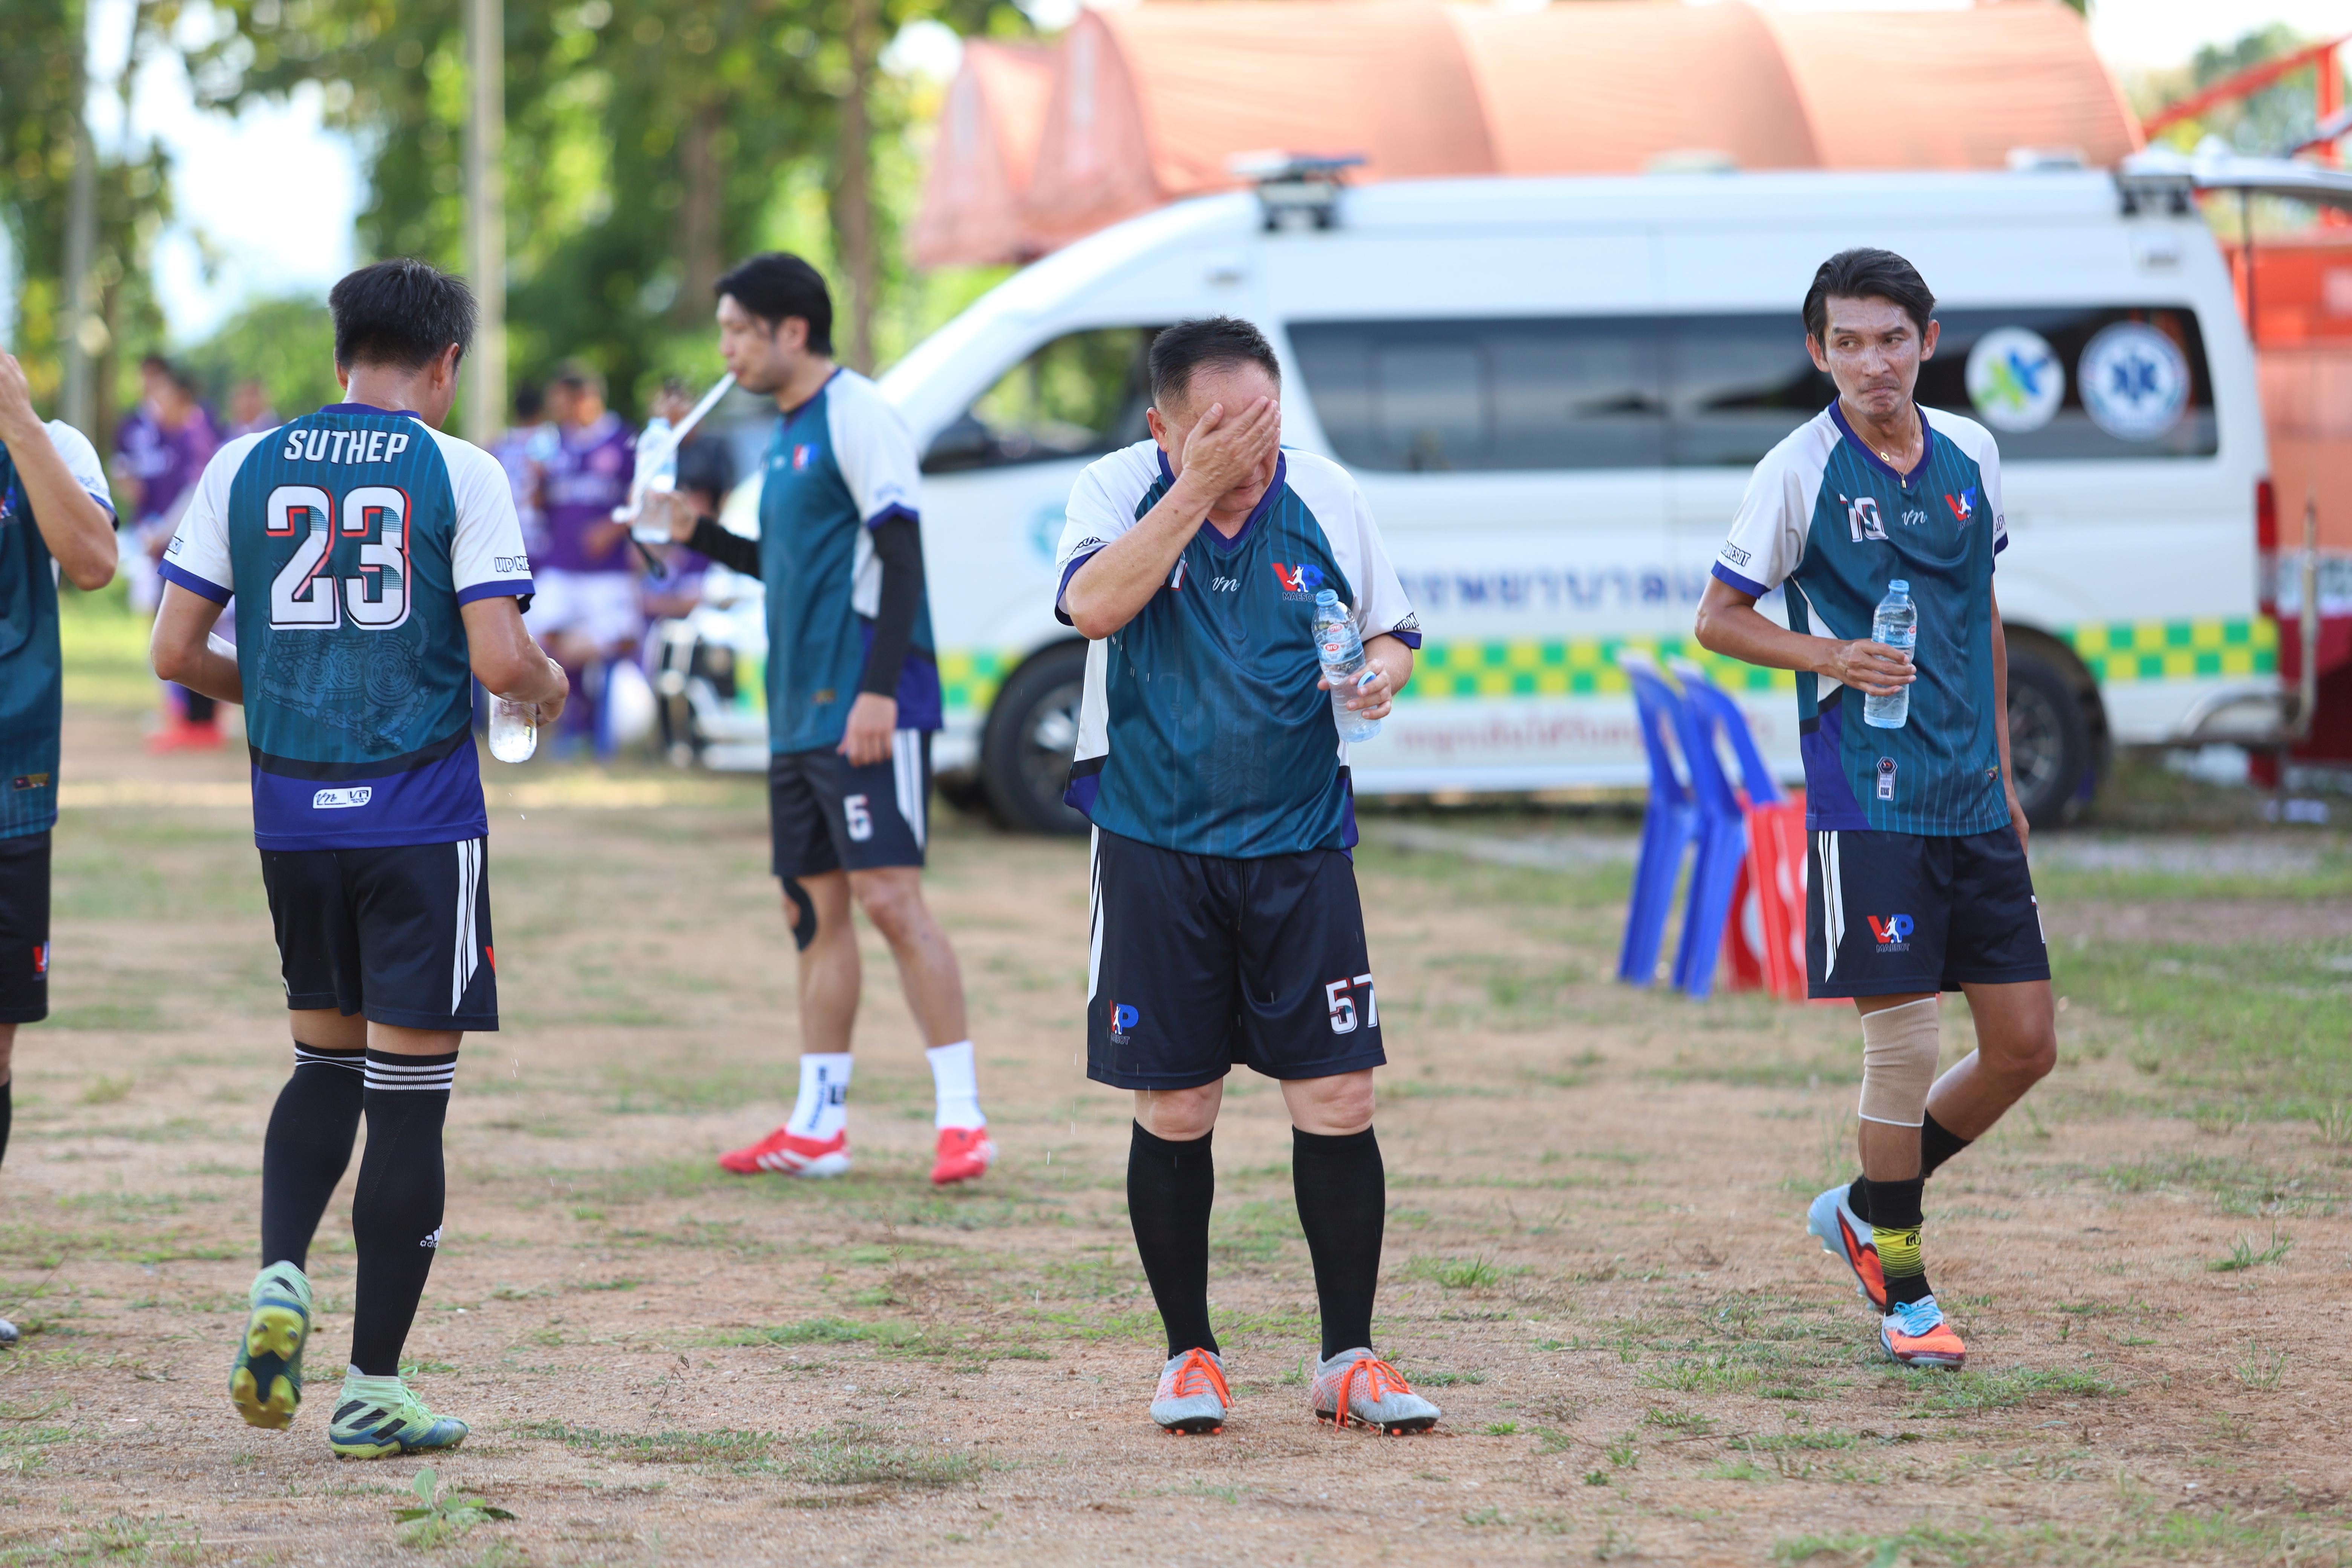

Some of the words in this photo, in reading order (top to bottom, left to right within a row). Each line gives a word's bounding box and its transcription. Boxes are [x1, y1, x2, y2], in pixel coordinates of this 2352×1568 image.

[284, 429, 409, 464] SUTHEP
[265, 484, 412, 630] 23
[1282, 591, 1317, 603] MAESOT
[844, 795, 874, 841] 5
[1325, 972, 1378, 1035] 57
